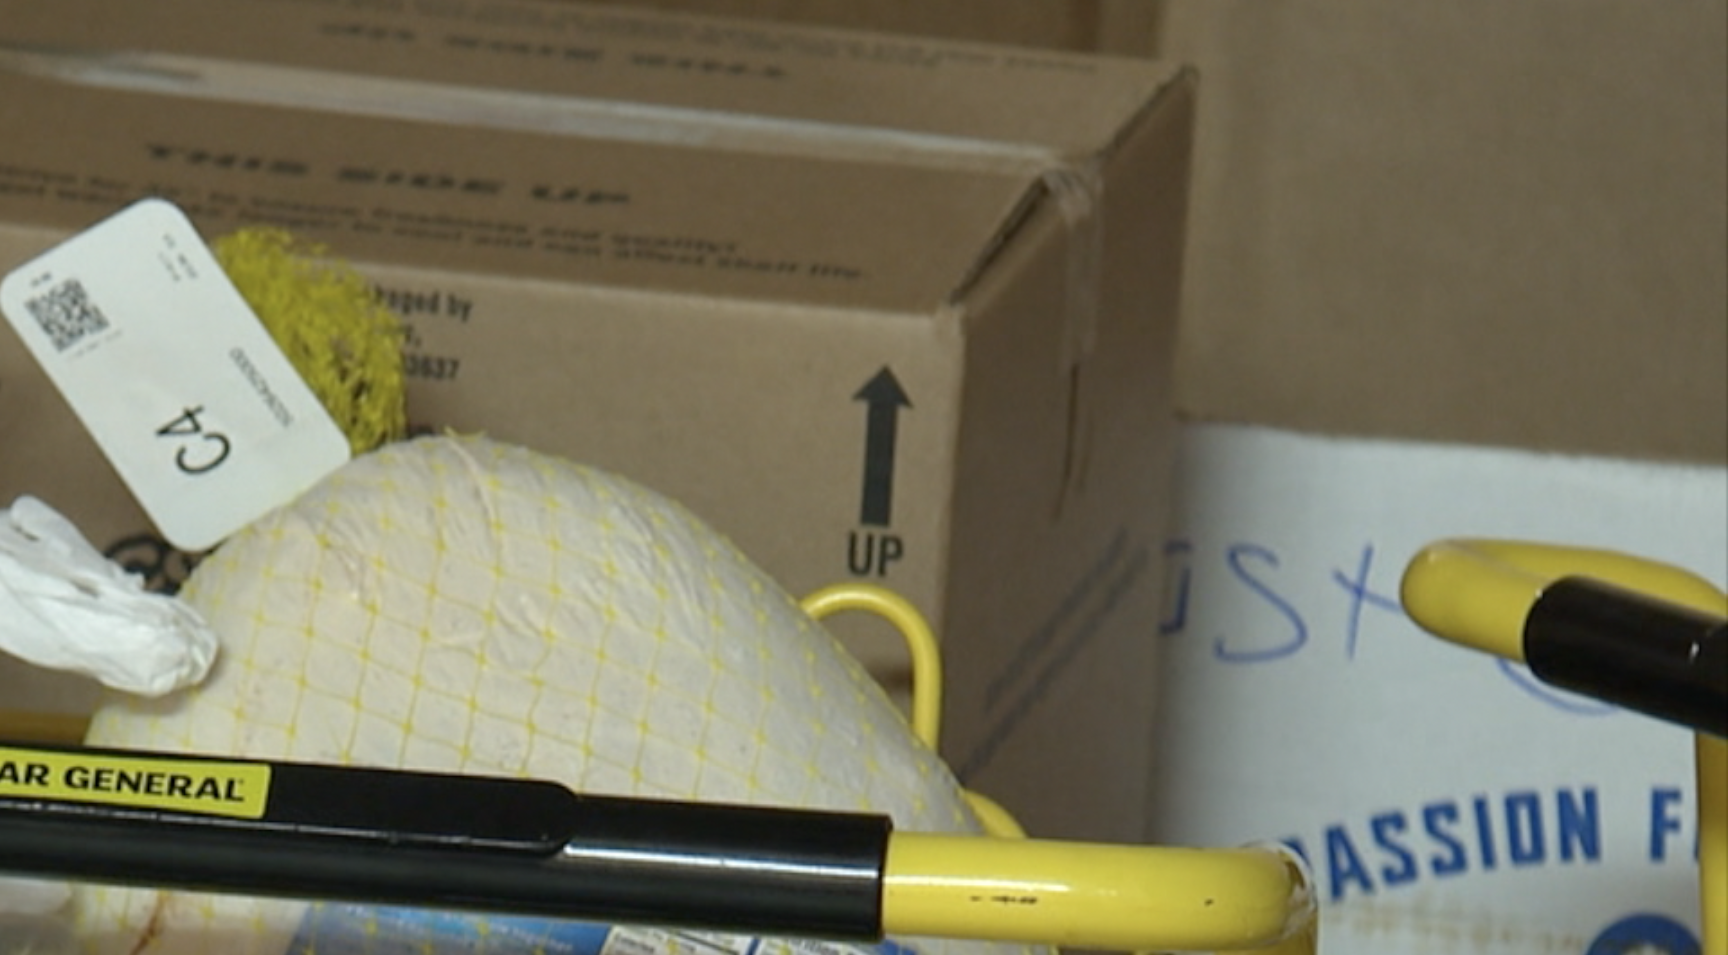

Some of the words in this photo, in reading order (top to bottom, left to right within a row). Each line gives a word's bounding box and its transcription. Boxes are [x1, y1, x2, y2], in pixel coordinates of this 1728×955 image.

[156, 404, 232, 475] C4
[847, 532, 904, 578] UP
[63, 766, 246, 803] GENERAL
[1280, 787, 1602, 900] ASSION
